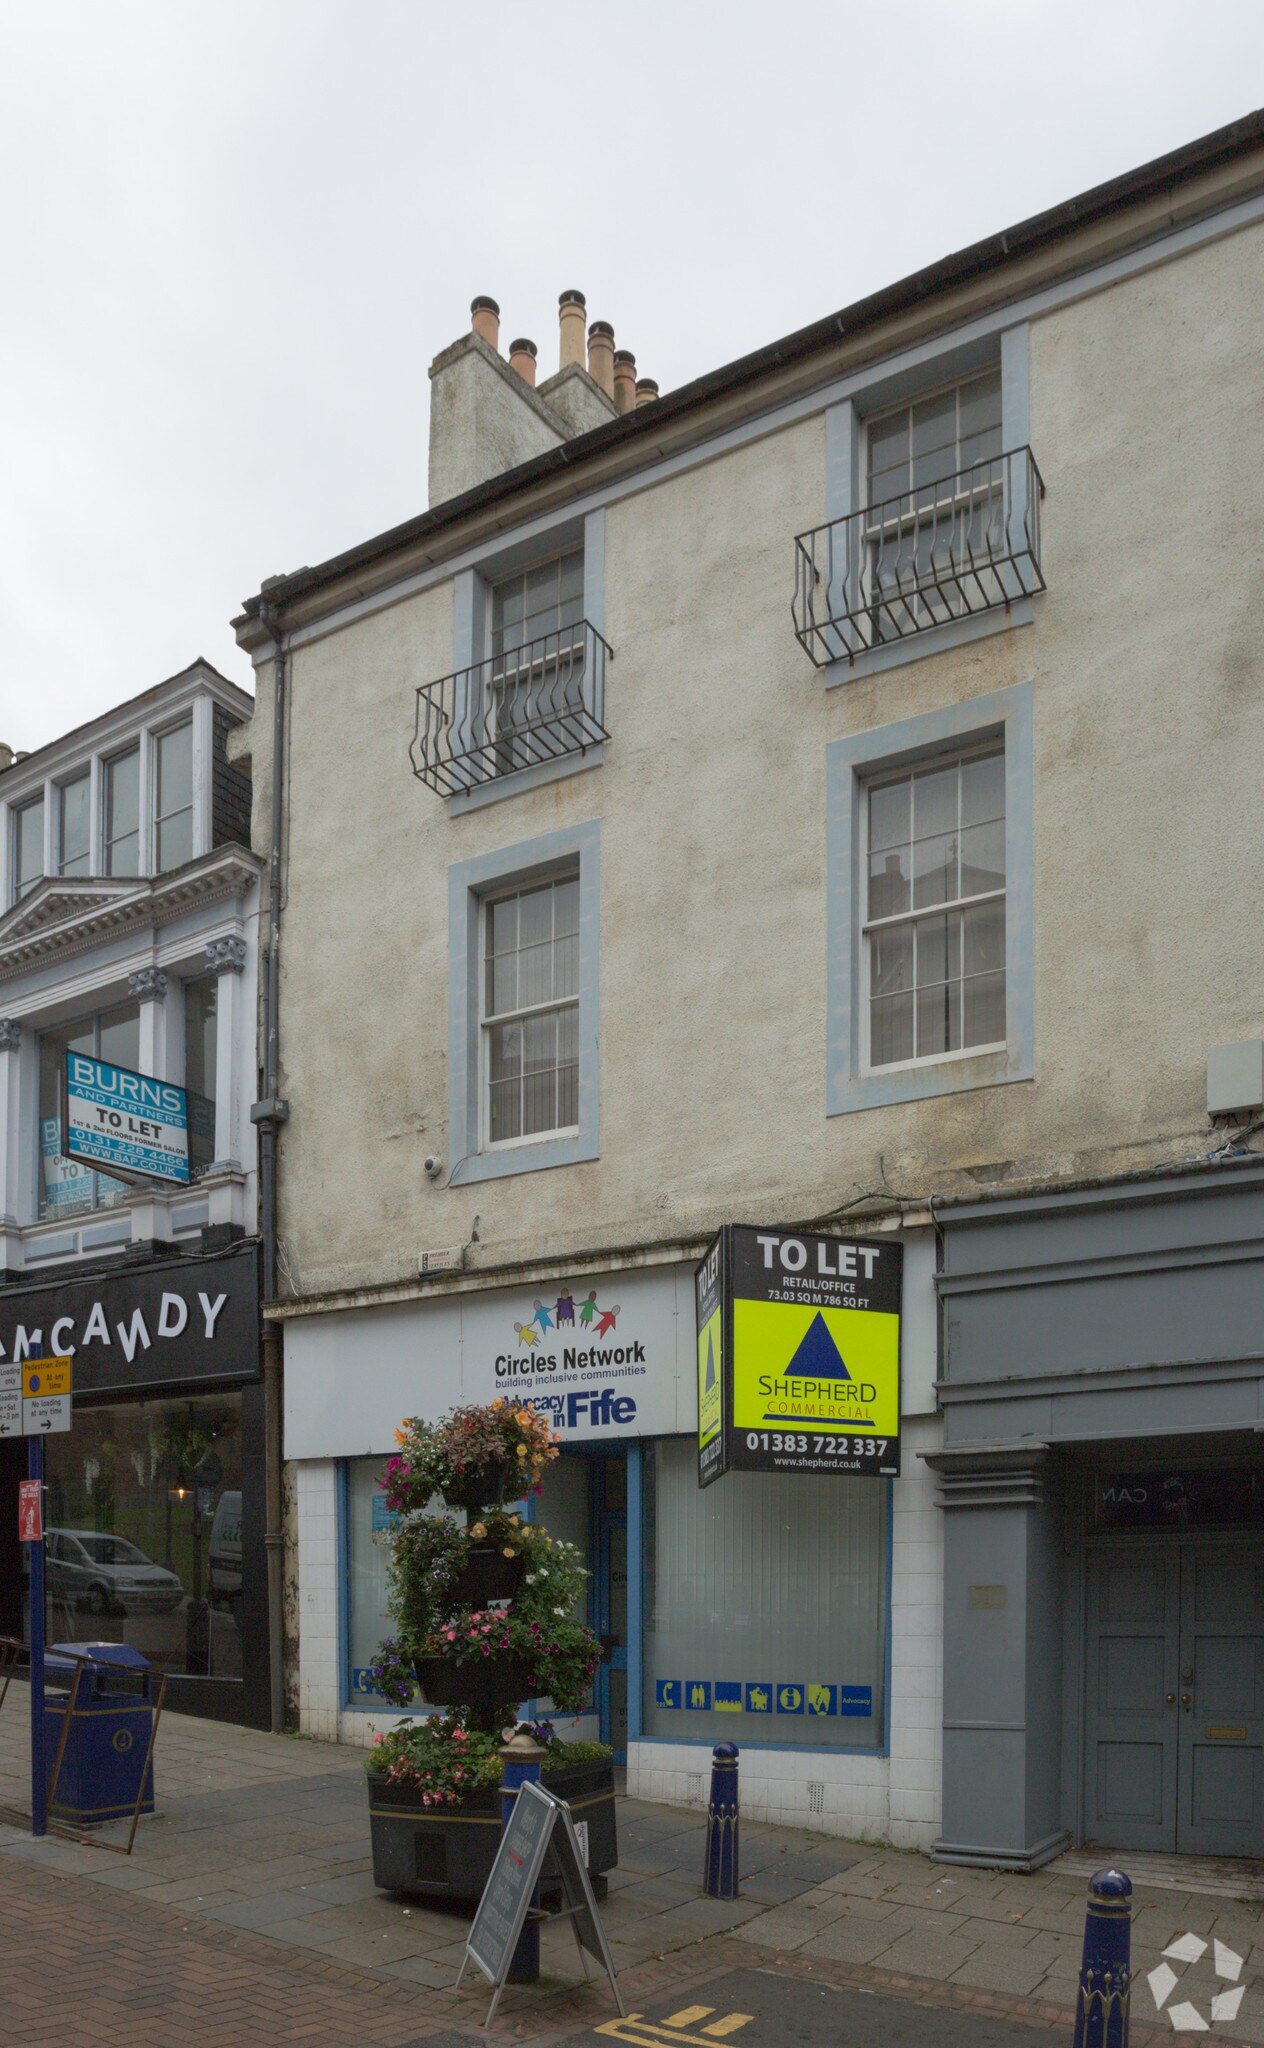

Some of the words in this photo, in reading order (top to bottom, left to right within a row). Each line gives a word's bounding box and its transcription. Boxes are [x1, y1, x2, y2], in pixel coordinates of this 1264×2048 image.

[75, 1058, 181, 1112] BURNS
[75, 1088, 105, 1102] AND
[111, 1099, 183, 1126] PARTNERS
[96, 1107, 122, 1128] TO
[129, 1117, 162, 1139] LET
[75, 1130, 110, 1147] 0131
[118, 1142, 144, 1156] 228
[149, 1151, 185, 1167] 4466
[106, 1129, 133, 1141] FLOORS
[135, 1136, 161, 1149] FORMER
[163, 1145, 186, 1155] SALON
[61, 1164, 78, 1180] TO
[80, 1143, 176, 1176] WWW.BAP.CO.UK
[757, 1235, 808, 1272] TO
[818, 1242, 880, 1279] LET
[699, 1266, 707, 1302] TO
[708, 1243, 719, 1289] LET
[782, 1276, 856, 1293] RETAIL/OFFICE
[768, 1290, 795, 1300] 73.03
[797, 1293, 810, 1302] SQ
[813, 1294, 821, 1303] M
[824, 1295, 841, 1305] 786
[843, 1297, 856, 1308] SQ
[858, 1299, 869, 1308] FT
[0, 1292, 227, 1363] MCANDY
[24, 1362, 53, 1371] Pedestrian
[495, 1352, 556, 1376] Circles
[564, 1340, 646, 1370] Network
[5, 1377, 16, 1385] only
[49, 1382, 61, 1390] time
[496, 1378, 532, 1389] building
[535, 1372, 578, 1384] inclusive
[581, 1366, 646, 1380] communities
[758, 1375, 877, 1403] SHEPHERD
[41, 1399, 61, 1407] loading
[553, 1410, 565, 1428] in
[567, 1388, 637, 1428] Fife
[767, 1401, 871, 1418] COMMERCIAL
[746, 1432, 808, 1453] 01383
[813, 1436, 848, 1455] 722
[853, 1438, 888, 1456] 337
[774, 1457, 861, 1469] www.shepherd.co.uk
[843, 1697, 870, 1705] Advocacy
